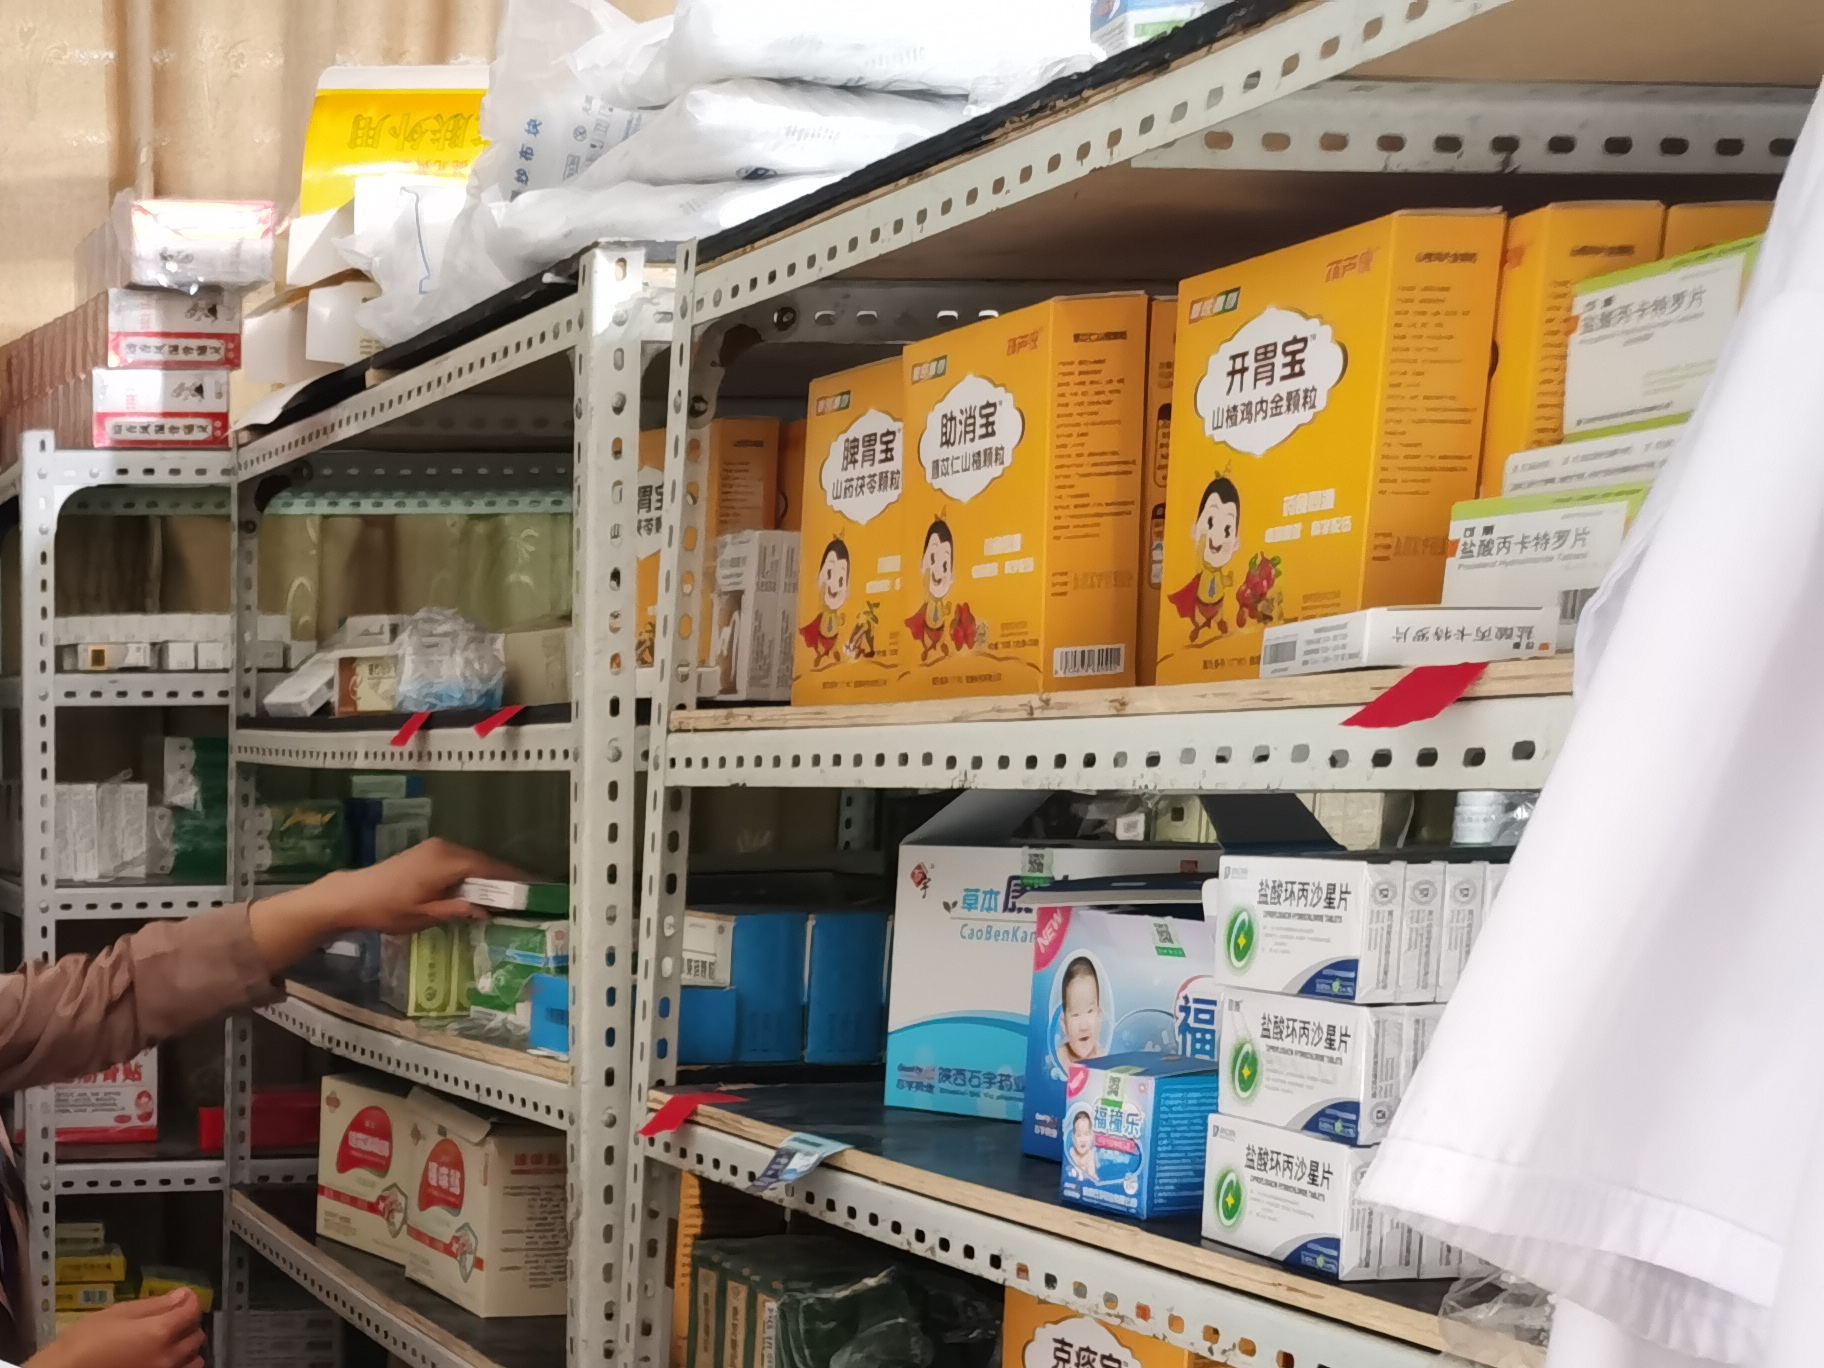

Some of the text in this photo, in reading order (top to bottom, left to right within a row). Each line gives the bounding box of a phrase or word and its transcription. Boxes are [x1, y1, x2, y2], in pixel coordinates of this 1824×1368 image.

[1226, 335, 1308, 396] 开胃宝
[939, 400, 998, 449] 助消宝
[1211, 385, 1317, 431] 山楂鸡内金颗粒
[840, 428, 897, 473] 脾胃宝
[931, 445, 1006, 480] 薏苡仁山楂颗粒
[831, 469, 901, 501] 山药茯苓颗粒
[1459, 527, 1591, 559] 盐酸丙卡特罗片
[1257, 879, 1352, 912] 盐酸环丙沙星片
[1036, 905, 1066, 953] NEW
[1259, 1011, 1352, 1054] 盐酸环丙沙星片
[1244, 1143, 1334, 1190] 盐酸环丙沙星片
